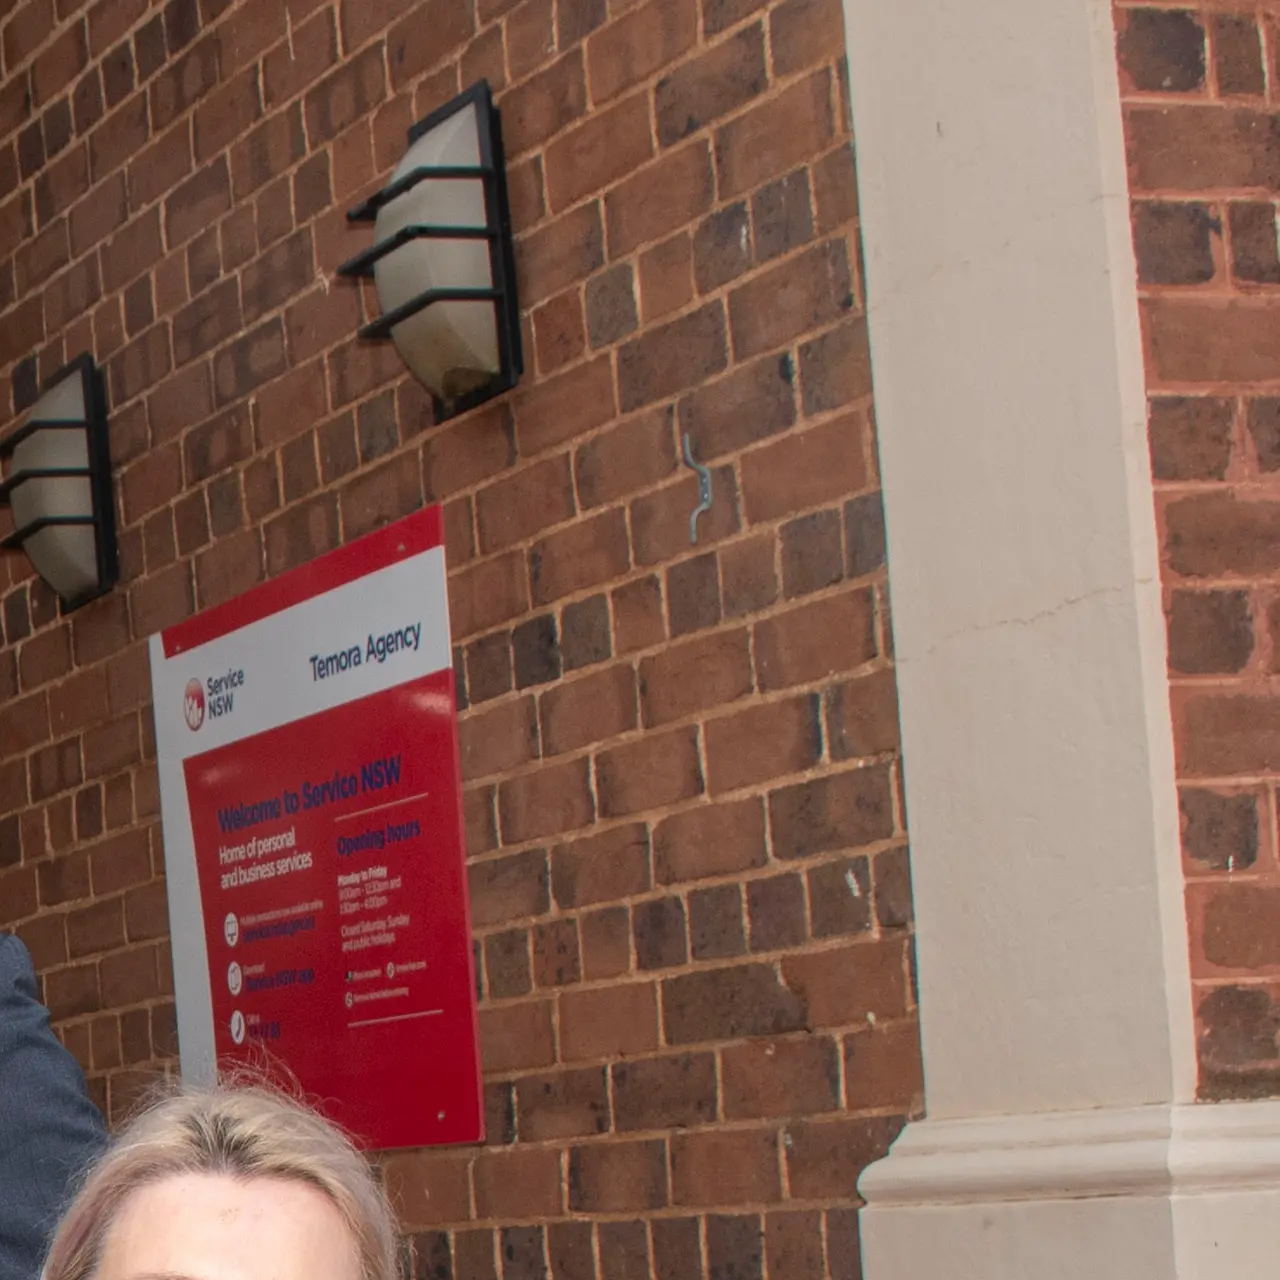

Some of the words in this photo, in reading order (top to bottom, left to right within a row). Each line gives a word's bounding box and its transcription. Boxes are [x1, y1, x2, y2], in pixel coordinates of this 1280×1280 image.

[309, 645, 362, 682] Temora
[366, 622, 422, 664] Agency
[207, 668, 245, 697] Service
[208, 693, 234, 720] NSW
[218, 796, 281, 834] Welcome
[283, 789, 300, 815] to
[302, 771, 358, 811] Service
[361, 753, 403, 792] NSW
[219, 843, 246, 865] Home
[246, 836, 258, 861] of
[257, 827, 296, 859] personal
[337, 827, 385, 857] Opening
[387, 820, 421, 843] hours
[220, 866, 240, 890] and
[239, 858, 277, 885] business
[276, 851, 313, 878] services
